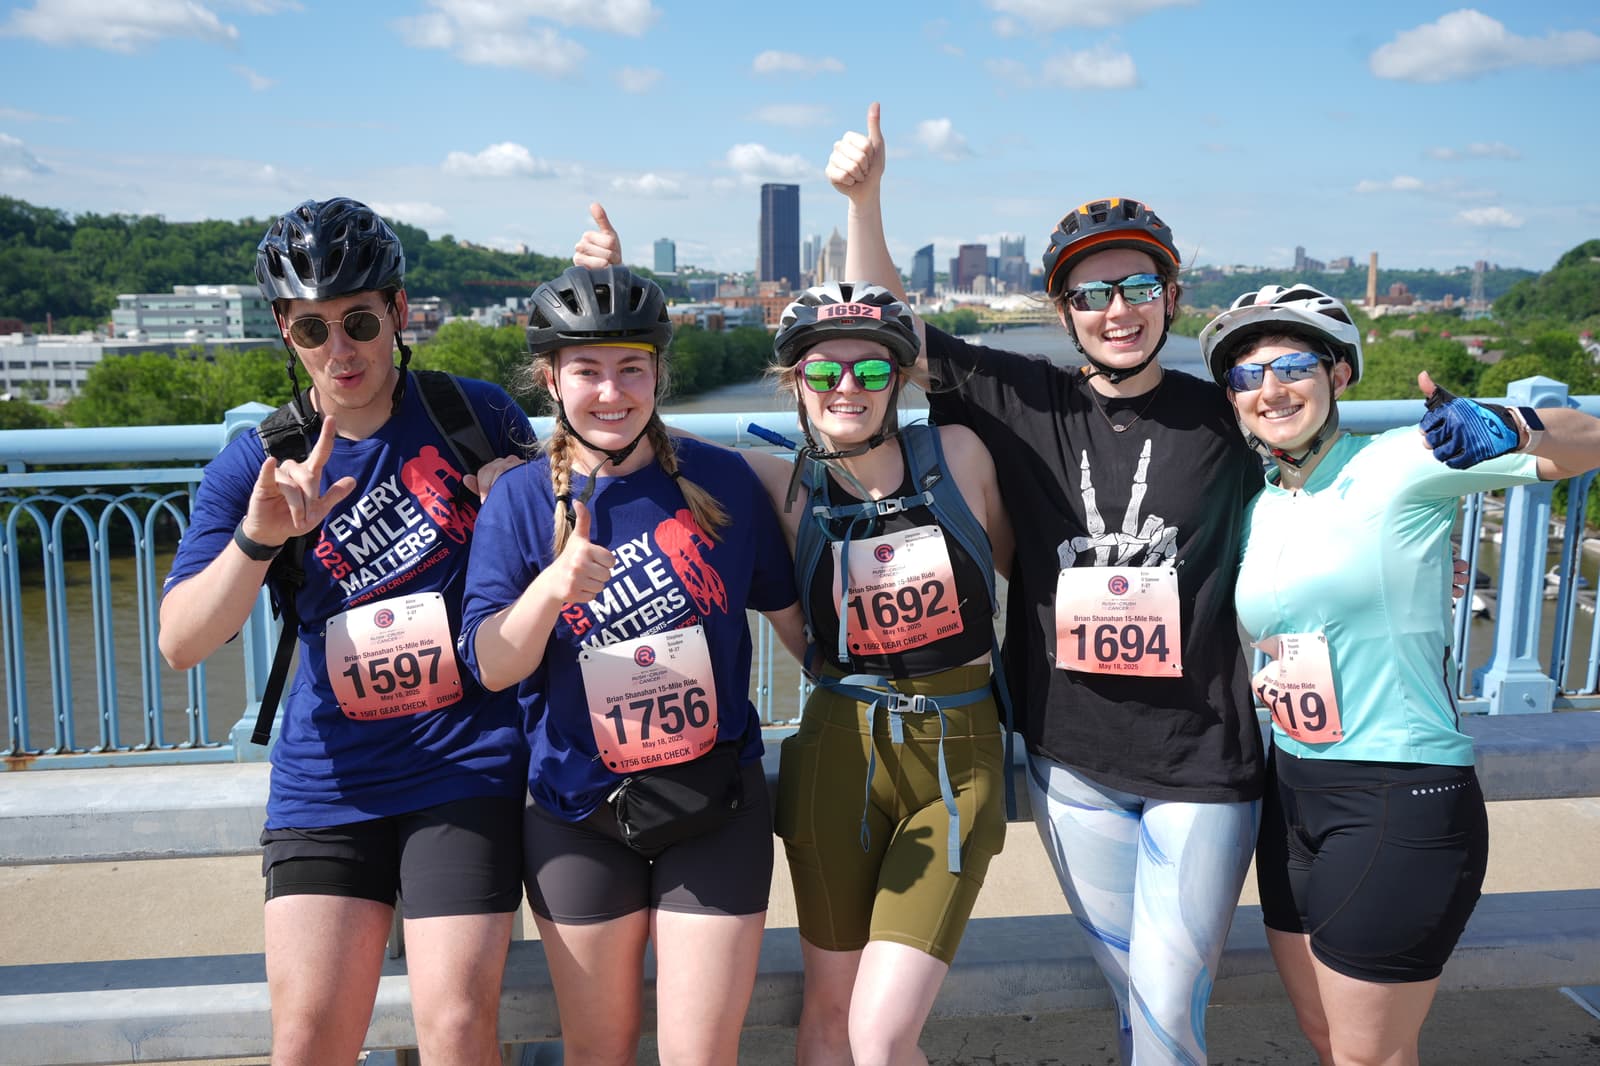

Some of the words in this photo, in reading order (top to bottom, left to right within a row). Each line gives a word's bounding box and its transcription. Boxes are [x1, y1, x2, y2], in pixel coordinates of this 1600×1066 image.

[826, 305, 873, 317] 1692
[328, 474, 401, 542] EVERY
[345, 497, 423, 565] MILE
[338, 522, 437, 597] MATTERS
[373, 587, 387, 597] TO
[387, 569, 417, 590] CRUSH
[416, 547, 450, 573] CANCER
[848, 587, 865, 595] Brian
[865, 580, 896, 591] Shanahan
[921, 571, 936, 579] Ride
[588, 558, 674, 624] MILE
[848, 580, 949, 631] 1692
[580, 587, 686, 650] MATTERS
[882, 628, 896, 636] May
[907, 622, 922, 631] 2025
[936, 622, 959, 635] DRINK
[344, 653, 362, 663] Brian
[362, 646, 394, 659] Shanahan
[395, 641, 419, 652] 15-Mile
[419, 638, 434, 647] Ride
[863, 642, 881, 650] 1692
[881, 639, 902, 649] GEAR
[903, 632, 928, 646] CHECK
[1070, 623, 1170, 663] 1694
[343, 646, 443, 699] 1597
[1099, 663, 1112, 671] May
[380, 693, 394, 702] May
[405, 688, 420, 697] 2025
[436, 692, 460, 704] DRINK
[606, 696, 624, 704] Brian
[625, 688, 657, 700] Shanahan
[658, 682, 683, 693] 15-Mile
[683, 678, 698, 686] Ride
[1301, 682, 1316, 690] Ride
[359, 709, 378, 718] 1597
[379, 705, 401, 715] GEAR
[401, 700, 427, 712] CHECK
[605, 686, 710, 745] 1756
[642, 741, 656, 749] May
[657, 738, 667, 747] 18,
[668, 734, 684, 743] 2025
[620, 759, 639, 769] 1756
[641, 754, 663, 764] GEAR
[664, 747, 691, 760] CHECK
